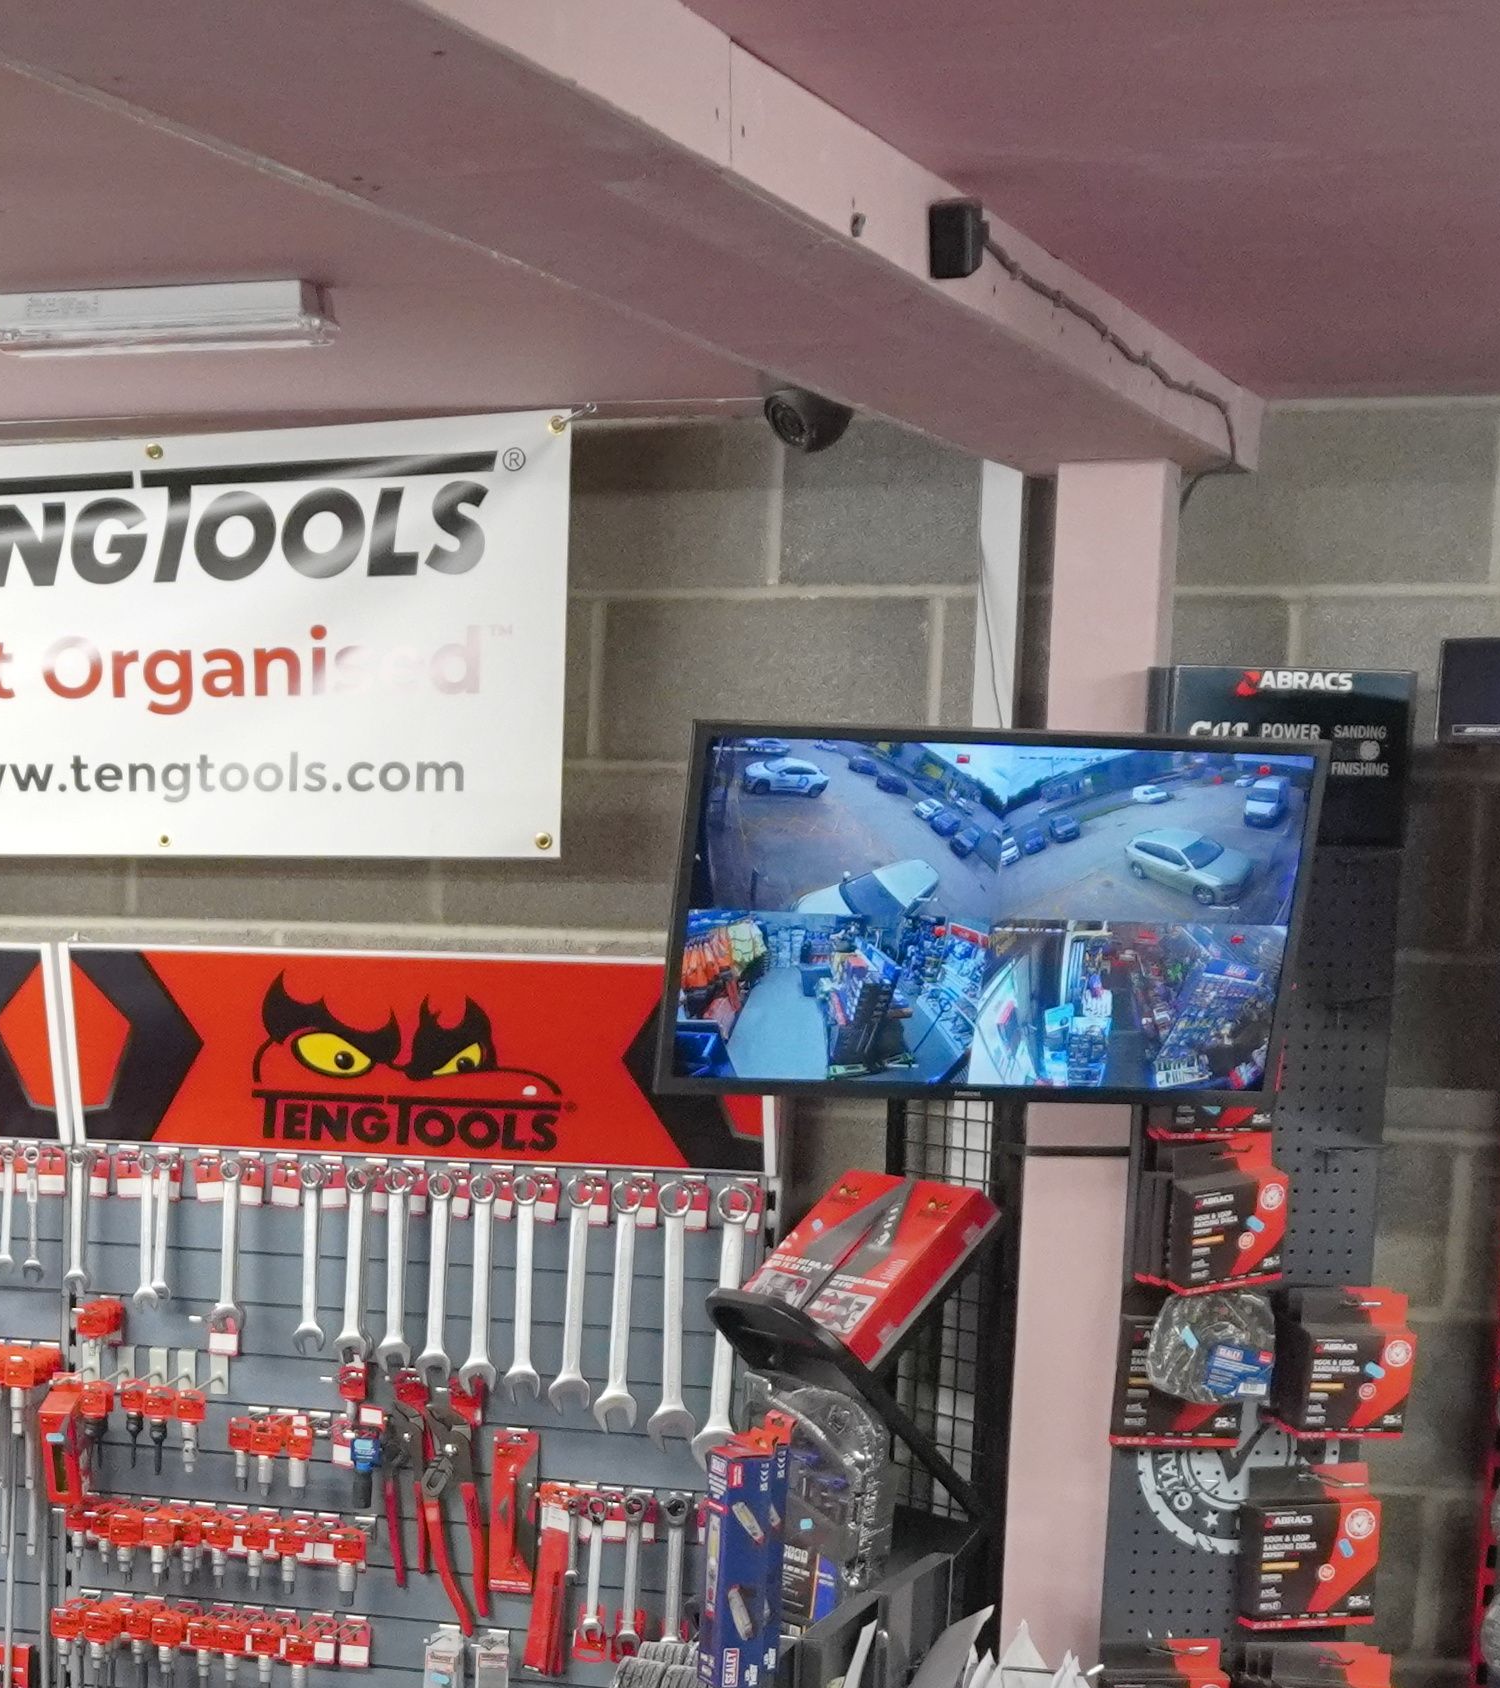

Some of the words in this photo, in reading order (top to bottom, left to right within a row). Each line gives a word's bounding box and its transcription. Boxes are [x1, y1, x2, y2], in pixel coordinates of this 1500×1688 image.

[1260, 670, 1353, 691] ABRACS
[1261, 723, 1321, 740] POWER
[1333, 724, 1387, 739] SANDING
[1331, 761, 1389, 777] FINISHING
[256, 1091, 563, 1154] TENGTOOLS
[1323, 1342, 1358, 1352] ABRACS
[1274, 1513, 1313, 1528] ABRACS
[1263, 1535, 1284, 1544] HOOK
[1291, 1534, 1311, 1543] LOOP
[721, 1647, 738, 1688] SEALEY
